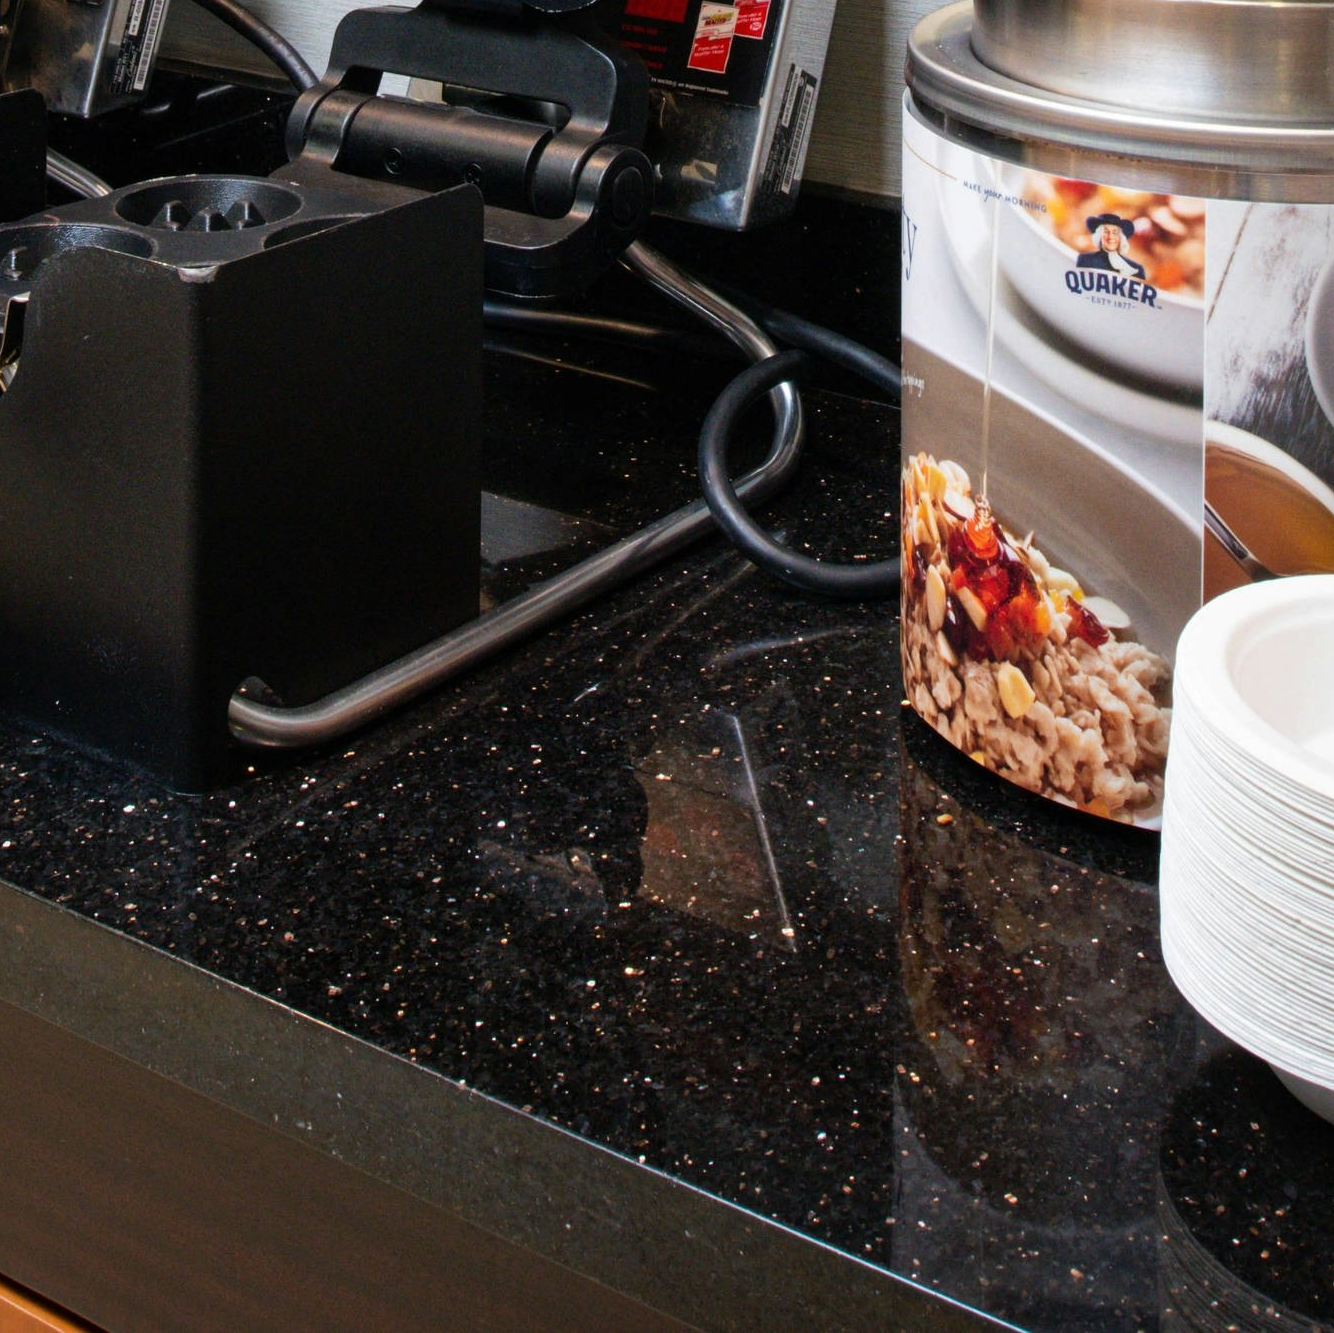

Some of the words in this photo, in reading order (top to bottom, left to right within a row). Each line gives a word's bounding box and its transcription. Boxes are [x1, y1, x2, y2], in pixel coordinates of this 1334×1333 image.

[963, 179, 982, 194] MAKE
[983, 185, 1003, 203] your
[1004, 194, 1048, 214] MORNING
[1064, 270, 1158, 309] QUAKER
